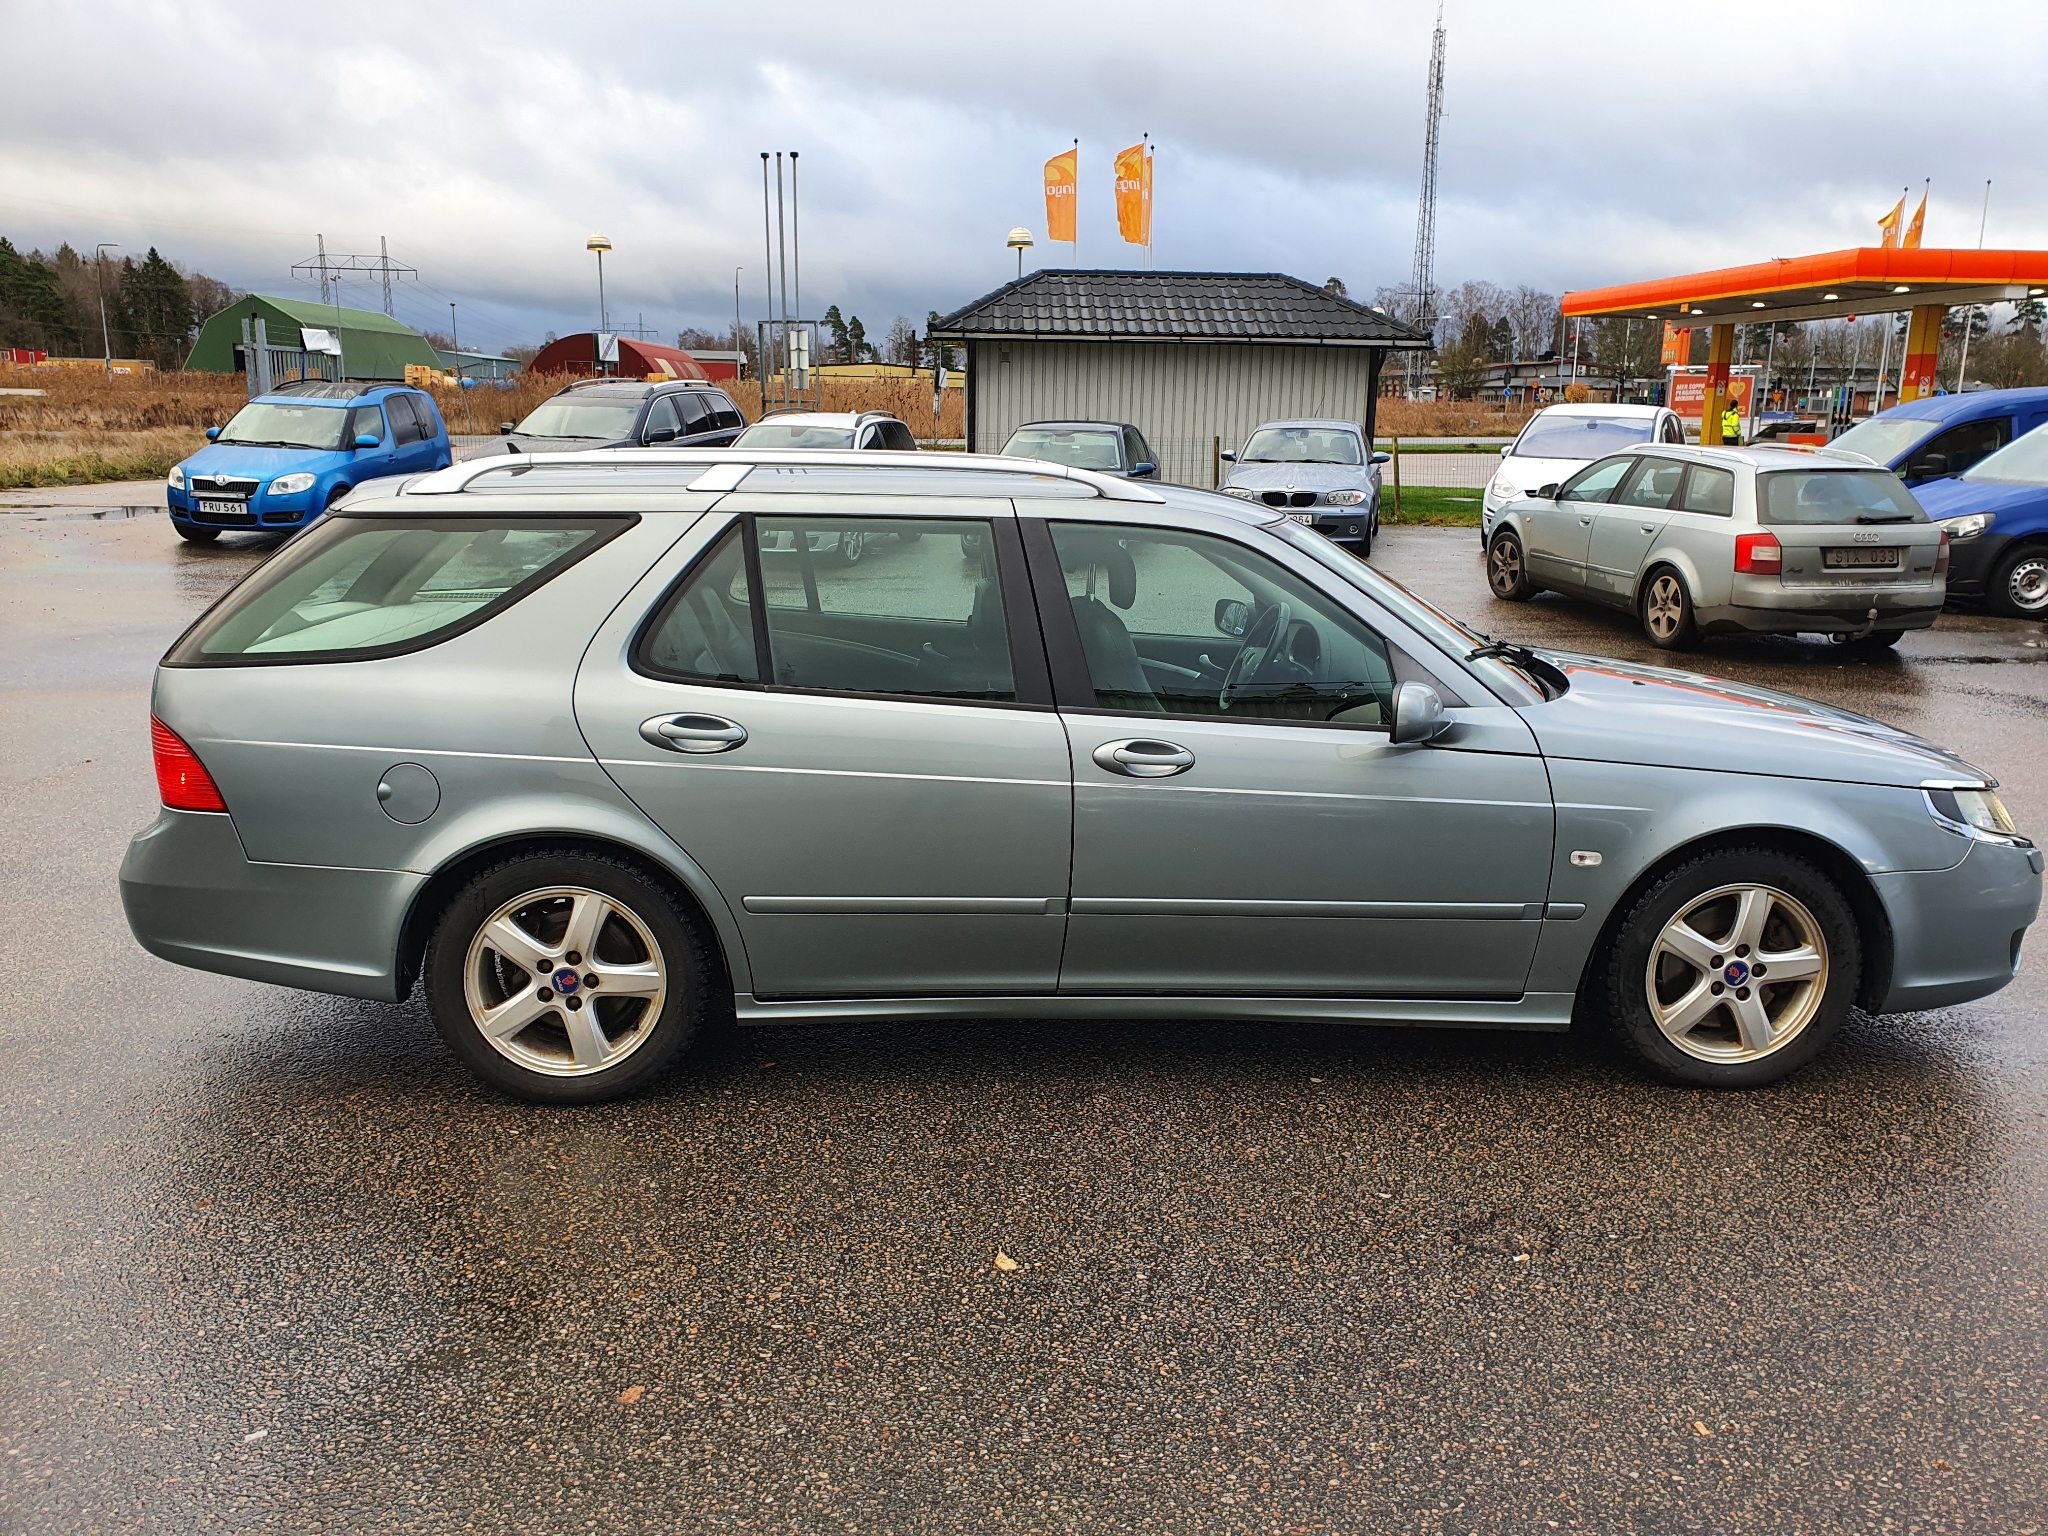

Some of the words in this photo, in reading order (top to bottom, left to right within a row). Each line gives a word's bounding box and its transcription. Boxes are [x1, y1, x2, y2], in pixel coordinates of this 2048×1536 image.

[1709, 374, 1715, 384] 2
[202, 501, 221, 512] FRU
[223, 503, 243, 513] 561
[1835, 551, 1861, 564] STX
[1870, 550, 1896, 563] 033
